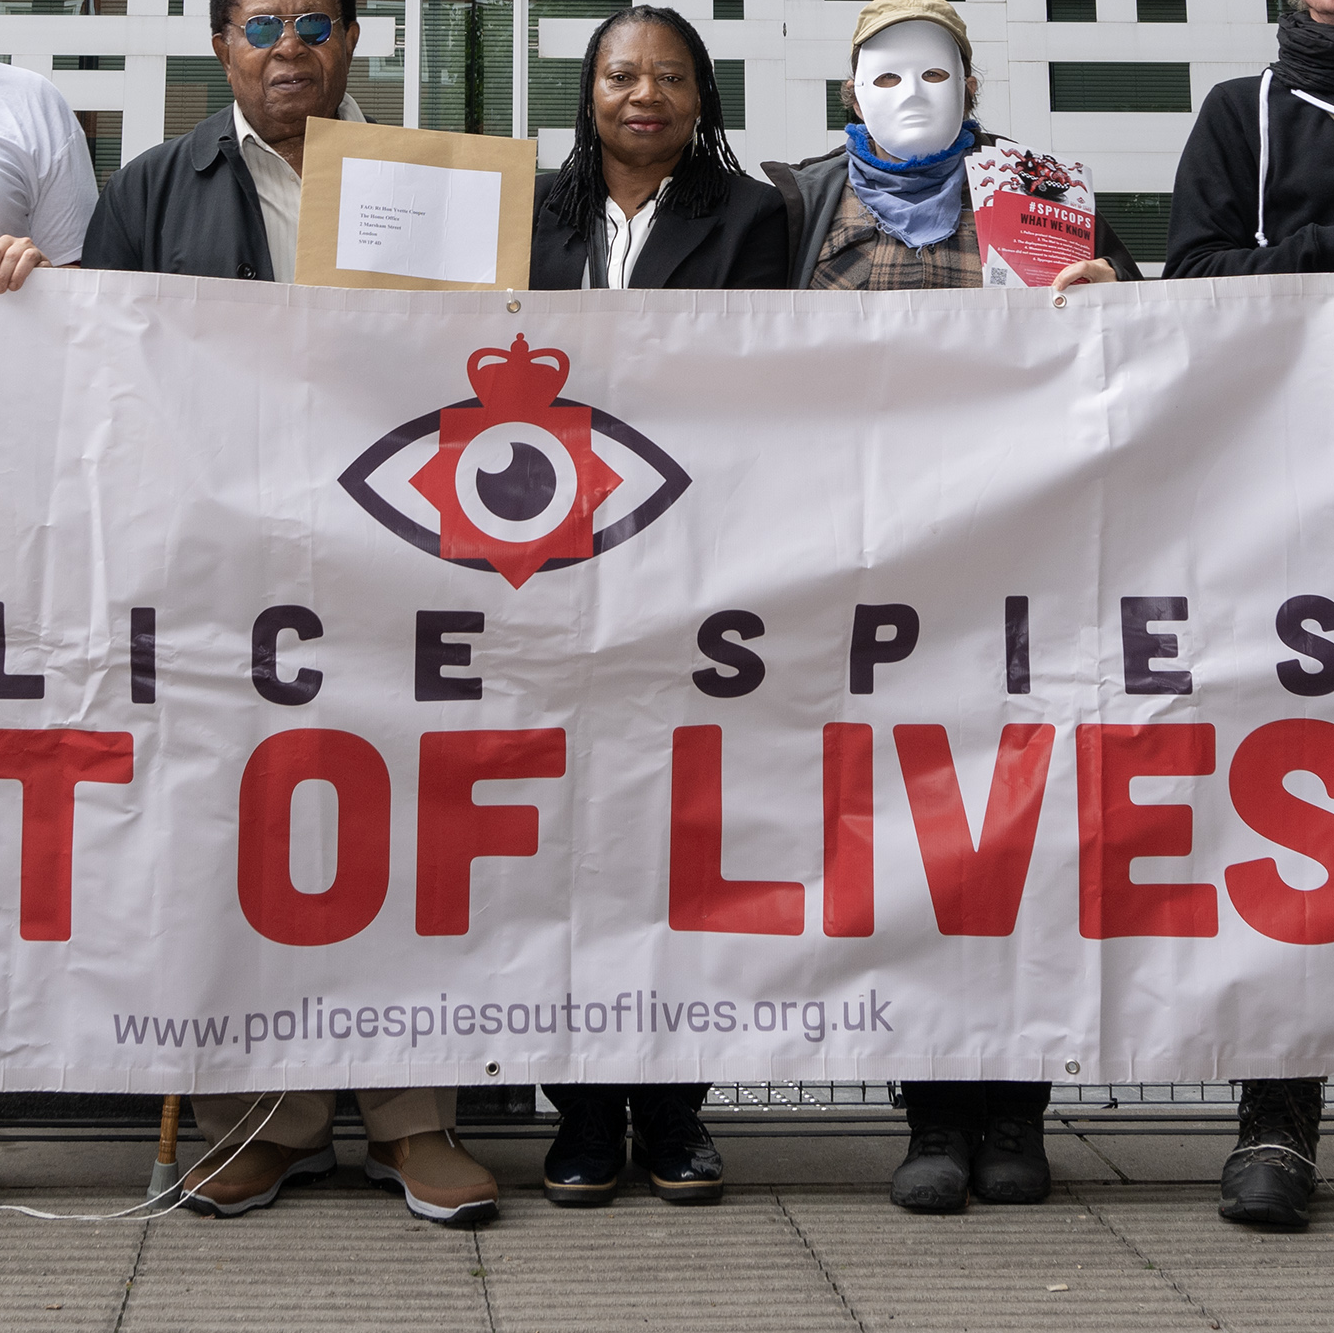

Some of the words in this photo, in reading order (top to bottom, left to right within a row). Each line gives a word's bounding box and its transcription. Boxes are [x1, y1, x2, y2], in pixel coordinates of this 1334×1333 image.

[1020, 214, 1047, 228] WHAT
[1050, 220, 1063, 232] WE
[1066, 224, 1091, 240] KNOW
[1029, 202, 1092, 228] #SPYCOPS
[237, 726, 567, 947] OF
[113, 990, 893, 1053] www.policespiesoutoflives.org.uk
